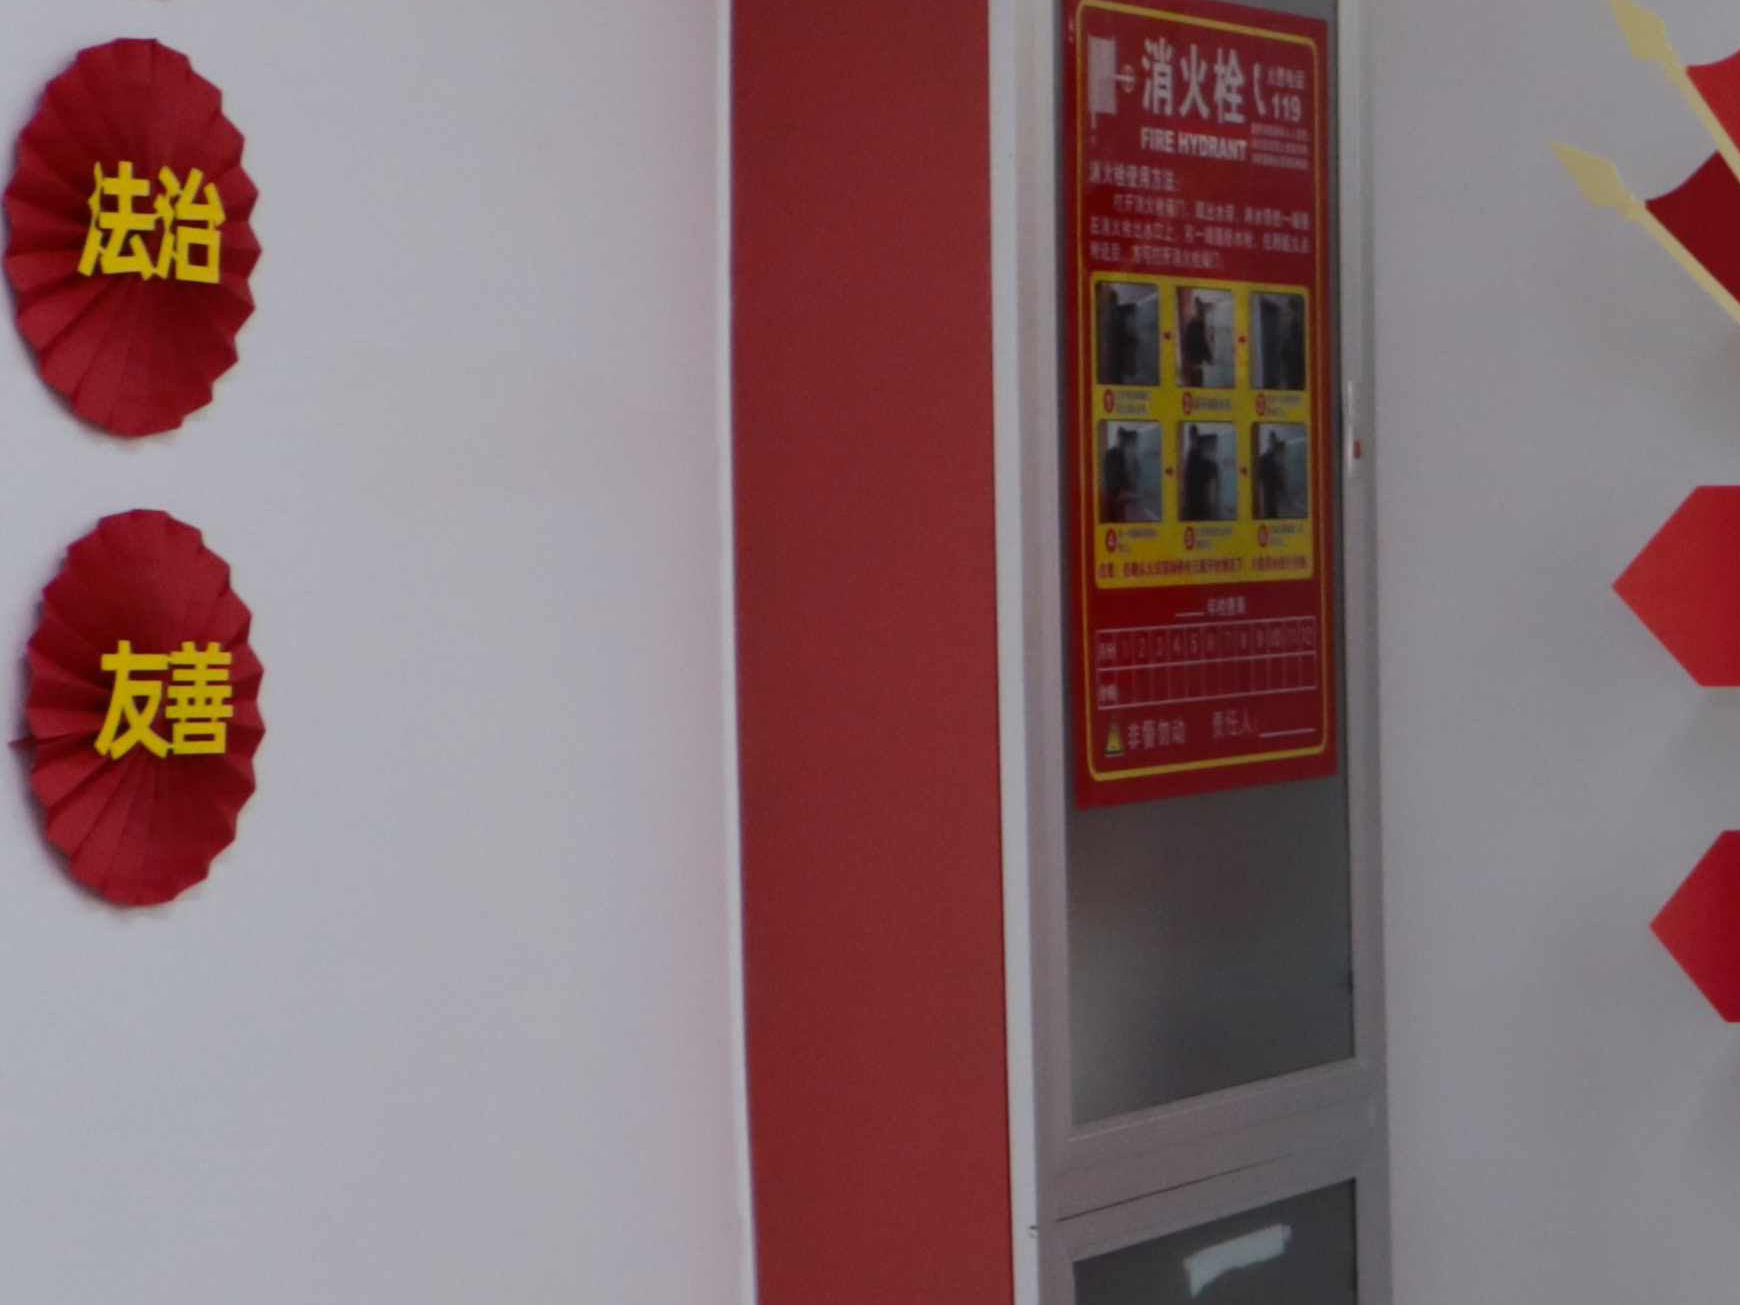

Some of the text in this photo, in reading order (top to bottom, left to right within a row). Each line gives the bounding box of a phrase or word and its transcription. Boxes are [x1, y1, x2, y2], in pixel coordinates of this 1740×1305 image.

[1141, 37, 1245, 124] 消火栓
[1272, 94, 1302, 122] 119
[1141, 127, 1175, 153] FIRE
[1178, 132, 1248, 161] HYDRANT
[78, 163, 223, 285] 法治
[95, 641, 234, 757] 友善
